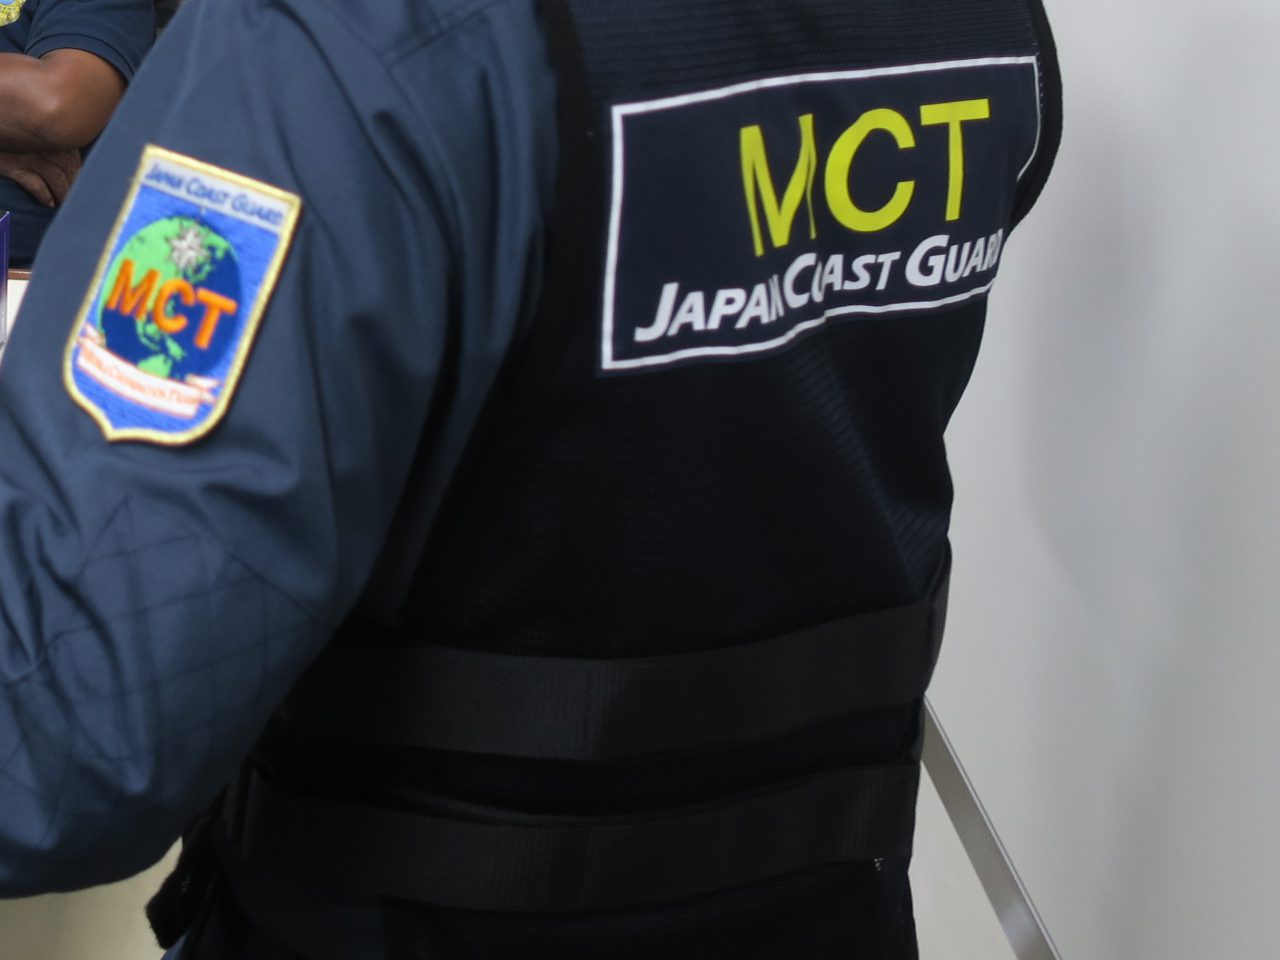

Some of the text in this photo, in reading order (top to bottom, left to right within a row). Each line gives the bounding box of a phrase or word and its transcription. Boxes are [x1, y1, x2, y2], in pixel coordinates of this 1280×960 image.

[740, 98, 990, 258] MCT
[107, 259, 238, 350] MCT
[634, 273, 785, 343] JAPAN
